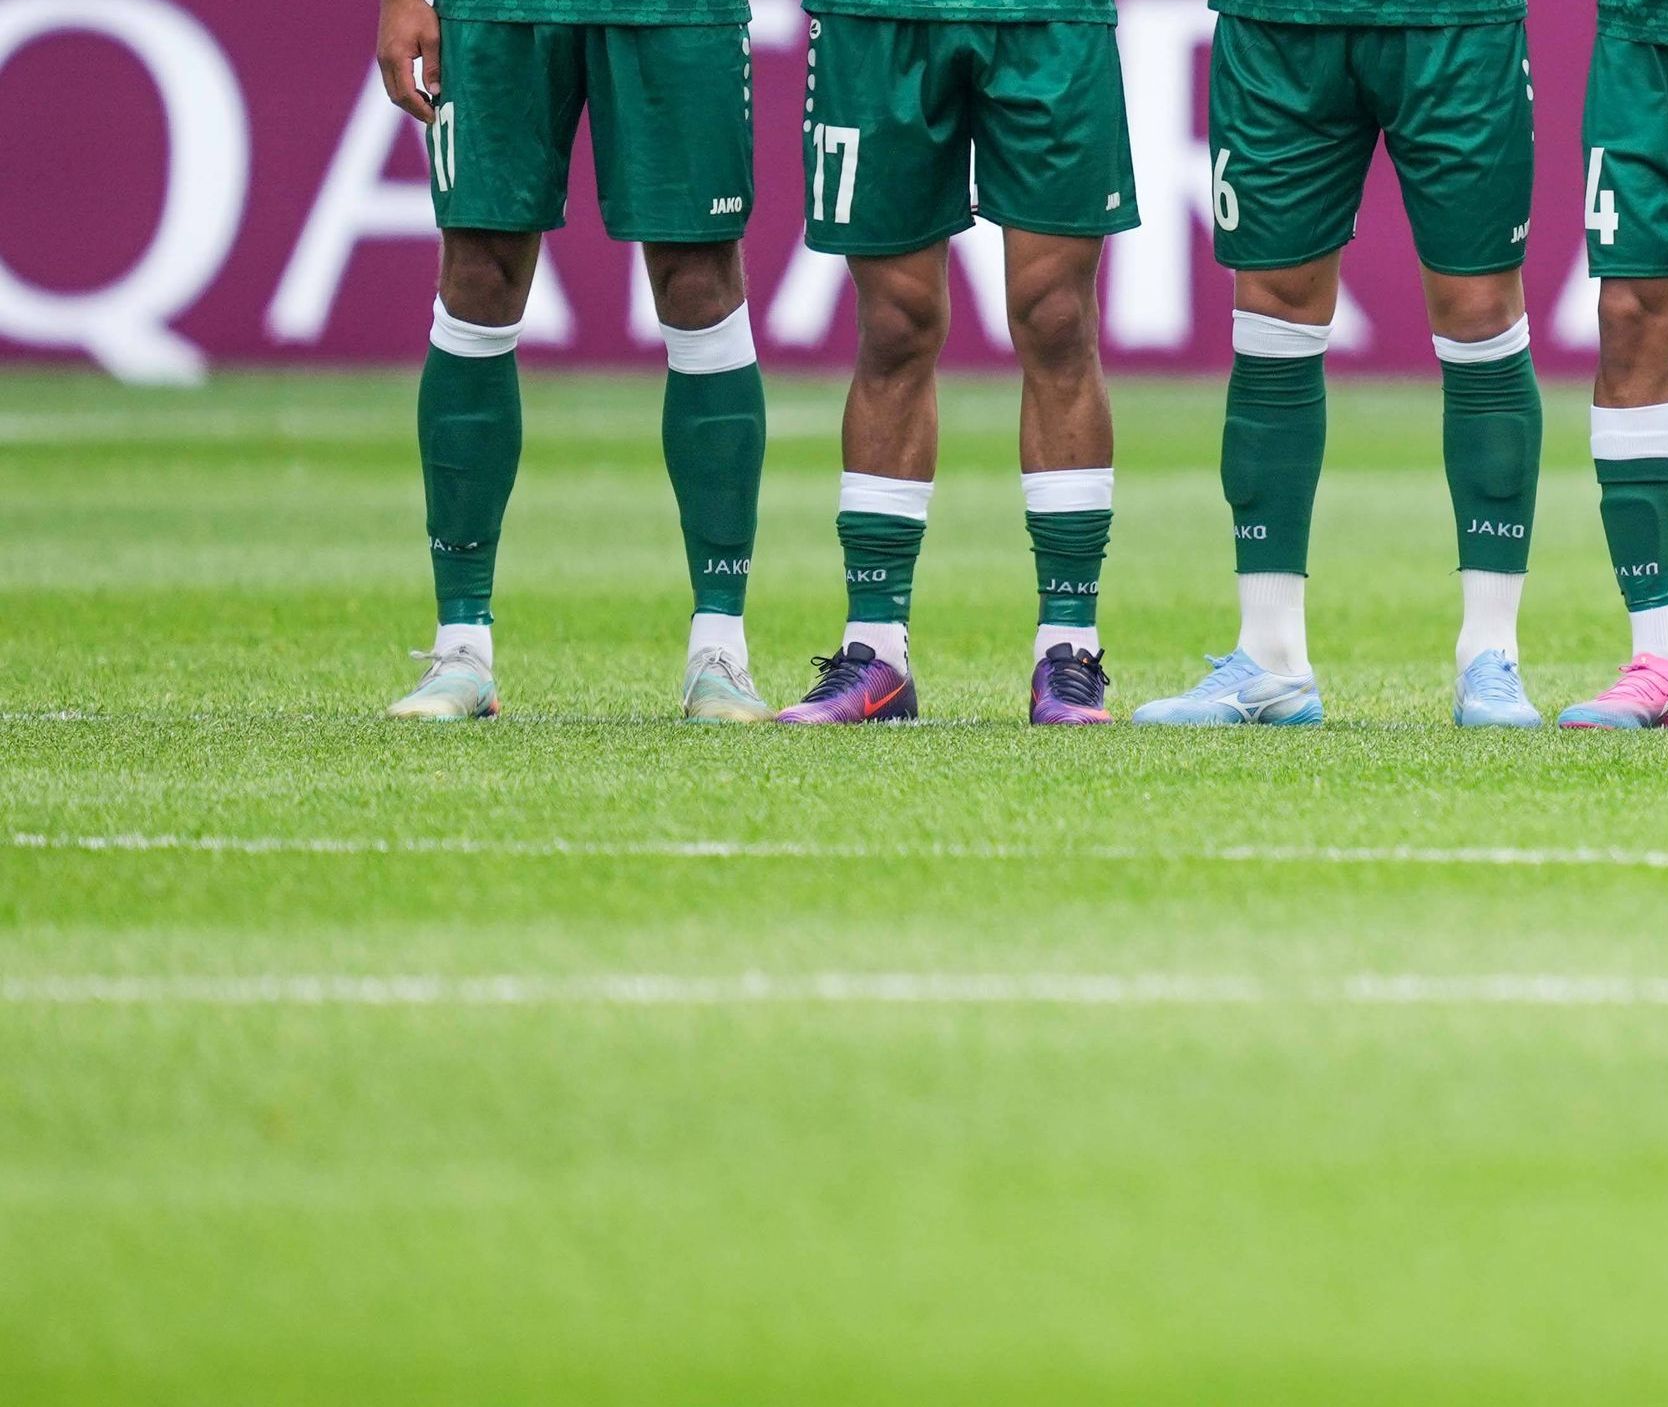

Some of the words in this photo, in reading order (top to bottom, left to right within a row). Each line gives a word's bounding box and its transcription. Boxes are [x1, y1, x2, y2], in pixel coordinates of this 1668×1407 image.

[813, 123, 860, 224] 17
[1213, 148, 1239, 232] 6
[1584, 147, 1619, 245] 4
[709, 196, 743, 215] JAKO
[1510, 217, 1531, 244] JAK
[1234, 525, 1267, 540] AKO
[1467, 519, 1525, 539] JAKO
[703, 559, 750, 576] JAKO
[846, 569, 887, 583] AKO
[1046, 578, 1099, 594] JAKO
